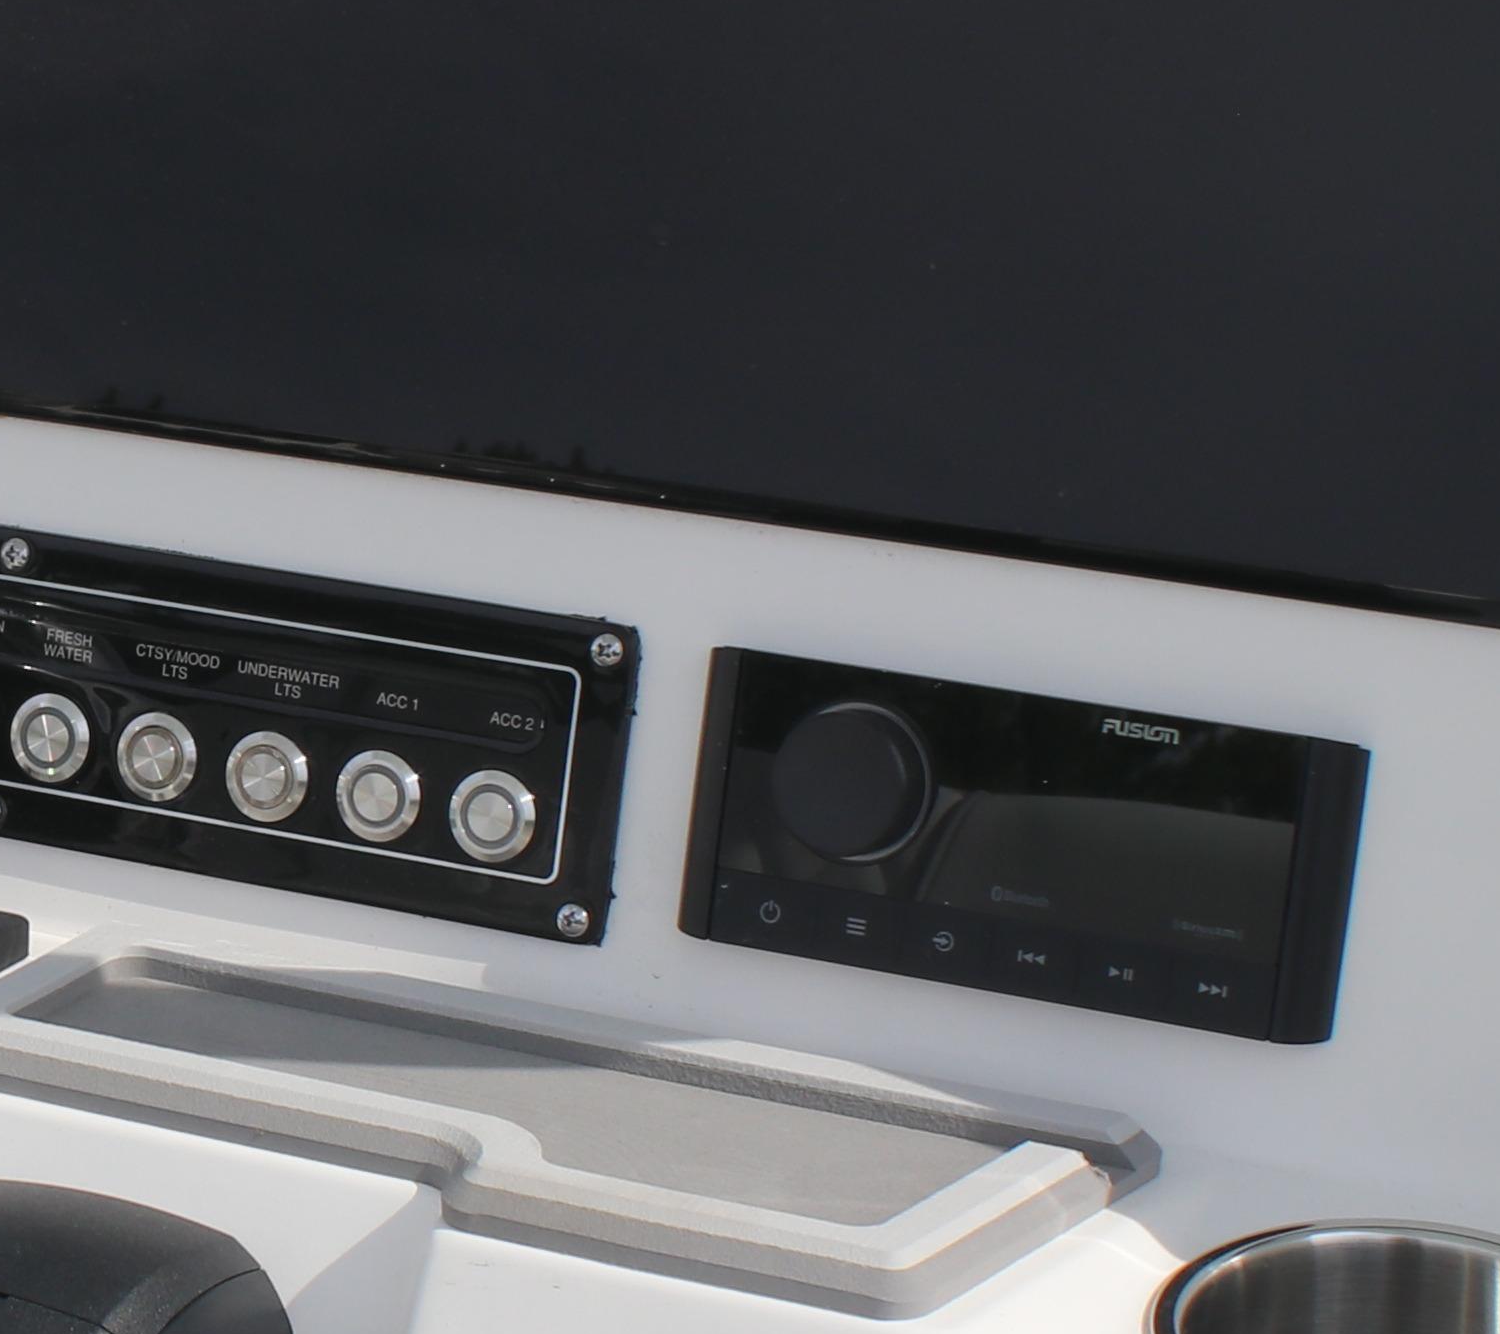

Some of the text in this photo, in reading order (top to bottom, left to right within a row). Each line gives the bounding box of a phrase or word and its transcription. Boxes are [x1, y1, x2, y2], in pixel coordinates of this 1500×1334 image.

[45, 627, 93, 648] FRESH
[42, 643, 93, 664] WATER
[134, 642, 220, 671] CTSY/MOOD
[161, 663, 188, 680] LTS
[236, 659, 341, 691] UNDERWATER
[273, 681, 302, 700] LTS
[375, 691, 419, 711] ACC 1
[489, 710, 535, 731] ACC 2
[1101, 718, 1180, 745] FUSION
